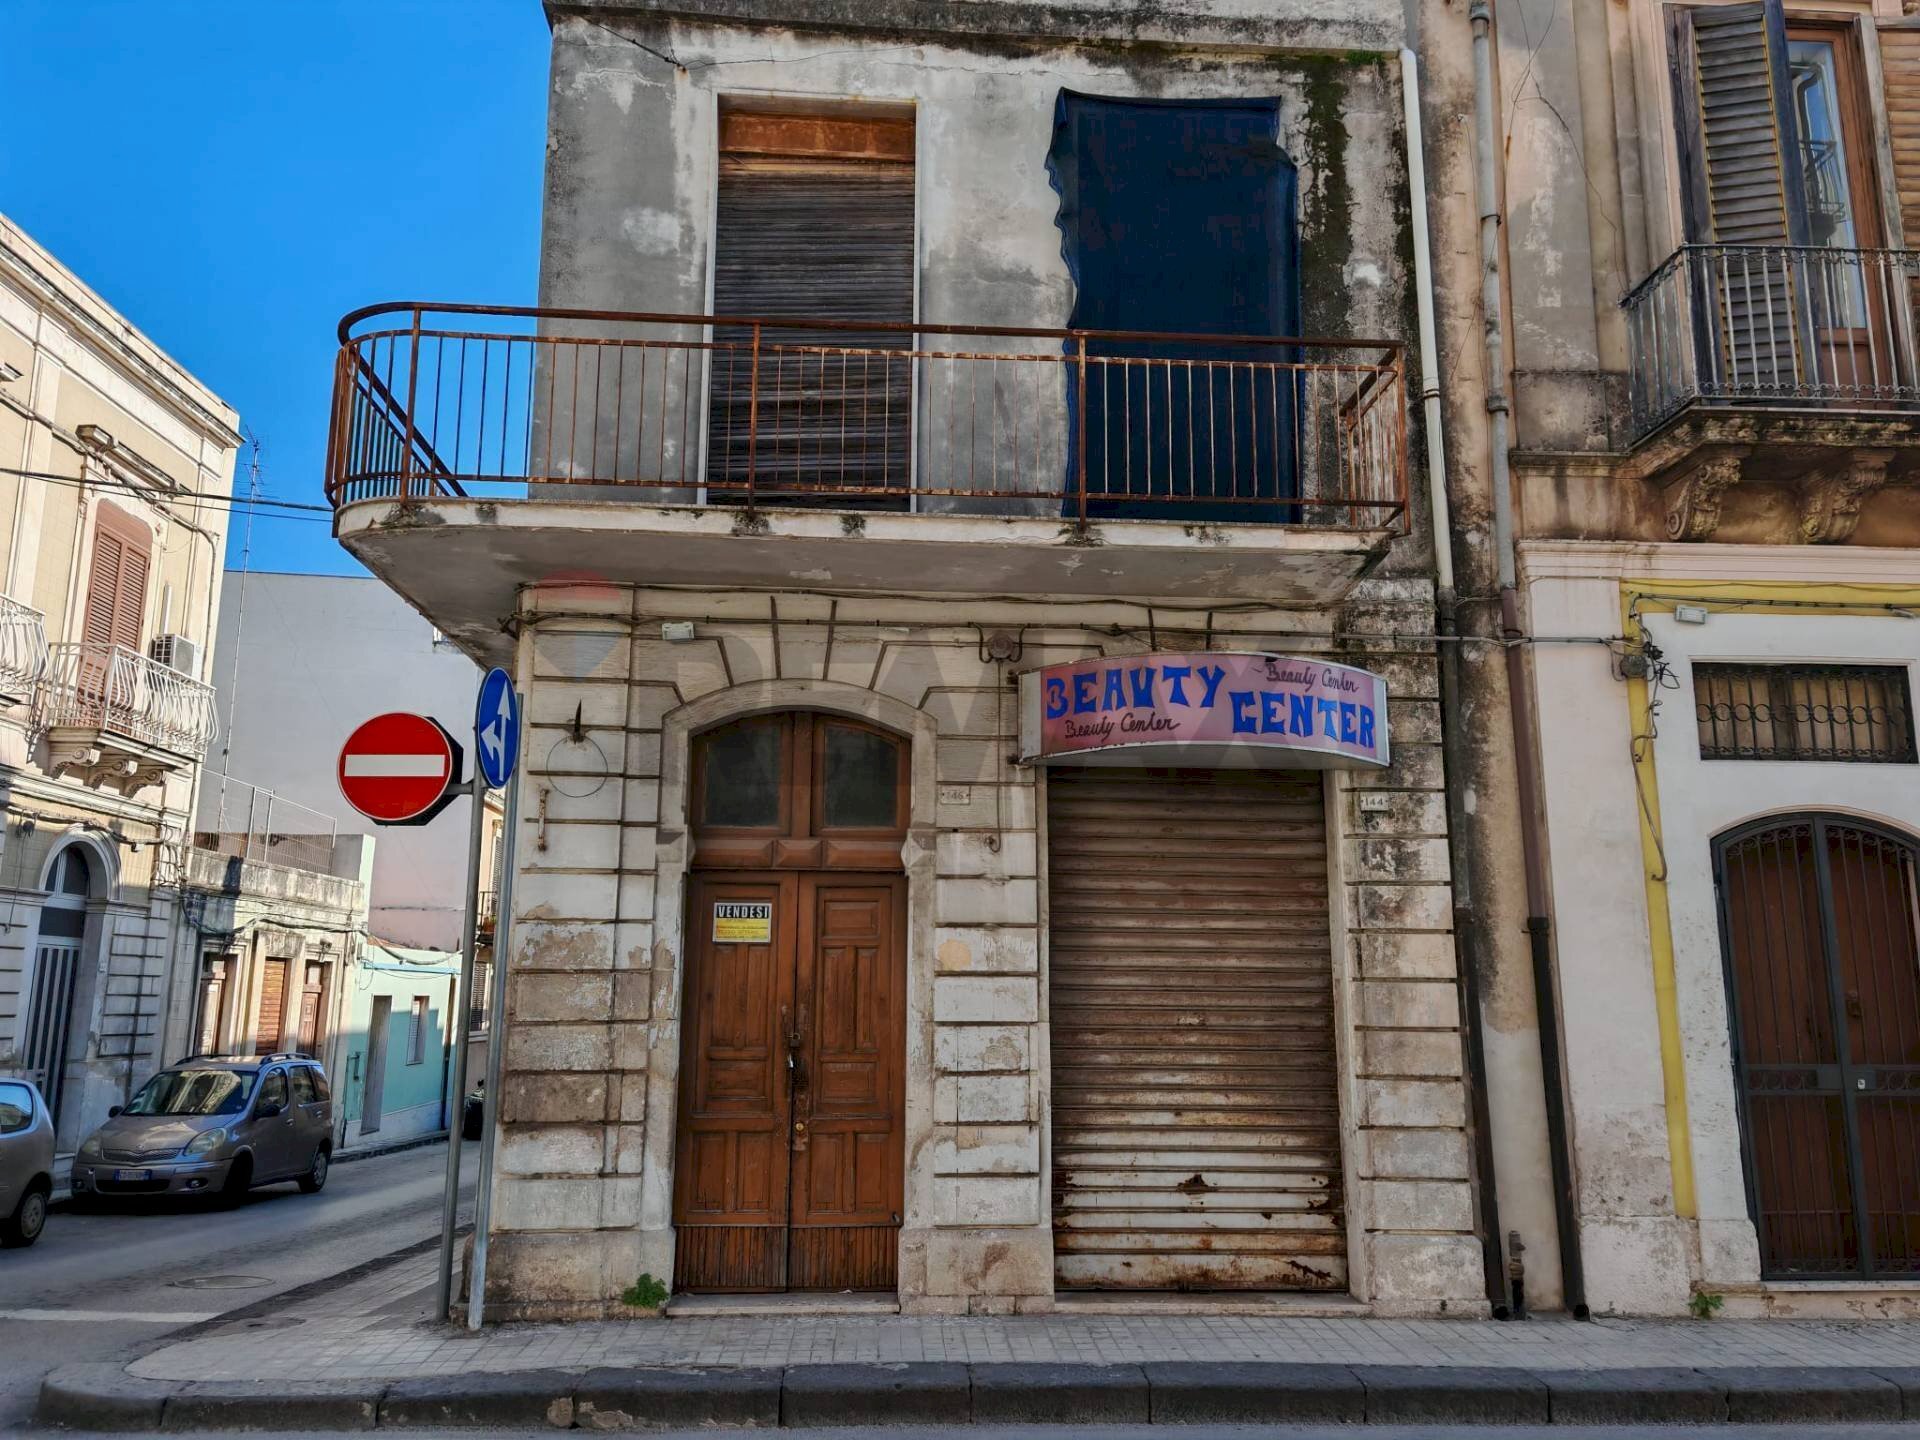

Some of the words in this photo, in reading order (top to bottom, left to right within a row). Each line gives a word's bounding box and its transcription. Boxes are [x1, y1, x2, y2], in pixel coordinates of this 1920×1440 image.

[1264, 661, 1317, 693] Beauty
[1321, 668, 1360, 693] Center
[1046, 663, 1227, 720] BEAUTY
[1228, 690, 1375, 750] CENTER
[1064, 715, 1115, 742] Beauty
[1120, 712, 1181, 733] Center
[1365, 796, 1384, 806] 144
[718, 906, 768, 918] VENDESI
